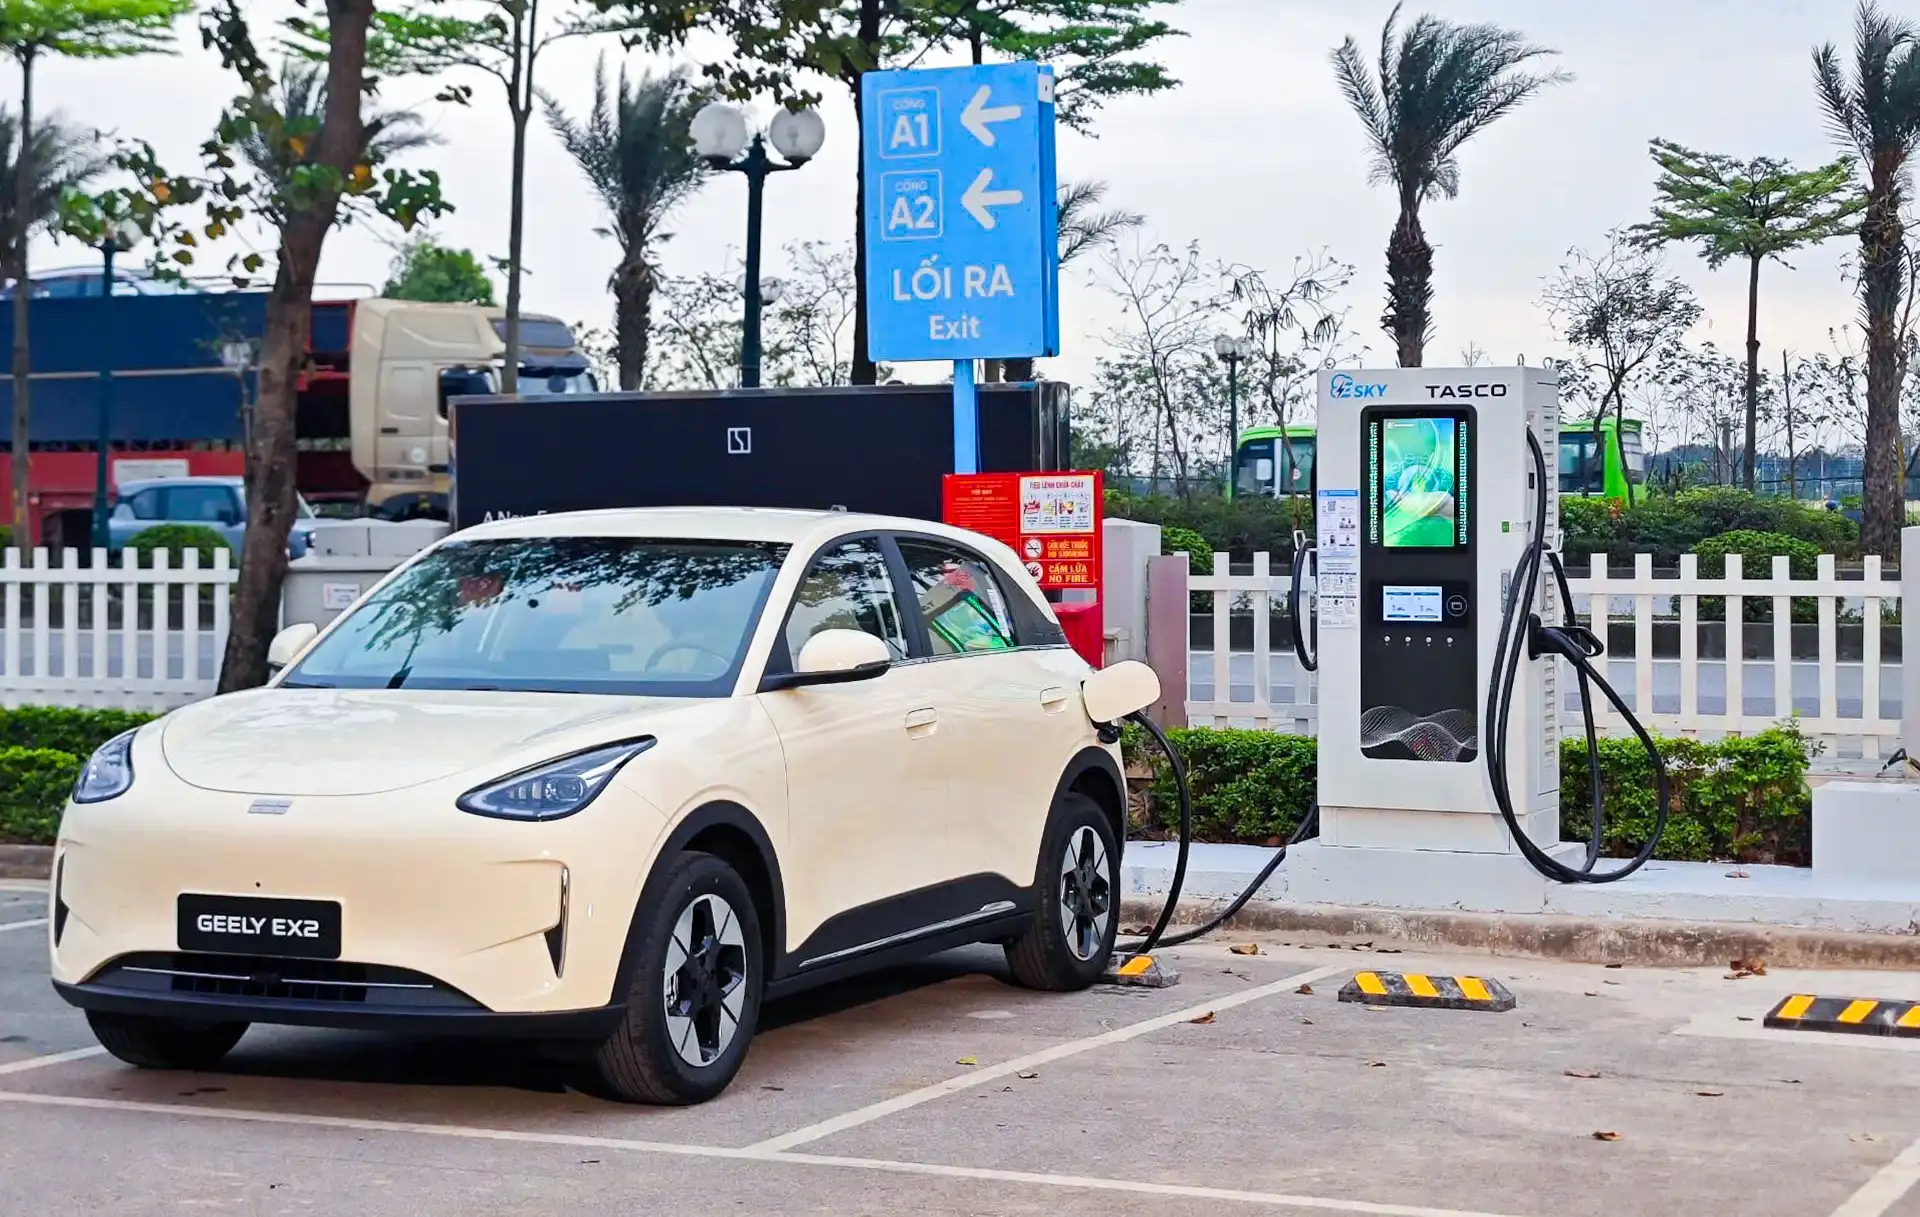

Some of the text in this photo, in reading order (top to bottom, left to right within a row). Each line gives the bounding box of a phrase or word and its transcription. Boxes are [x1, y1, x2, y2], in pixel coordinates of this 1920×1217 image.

[889, 113, 929, 149] A1
[889, 195, 936, 231] A2
[893, 253, 1015, 301] LỐI RA
[929, 315, 981, 340] Exit
[1425, 384, 1507, 398] TASCO
[1048, 562, 1068, 573] CẤM
[1048, 574, 1088, 583] NO FIRE
[197, 914, 319, 938] GEELY EX2
